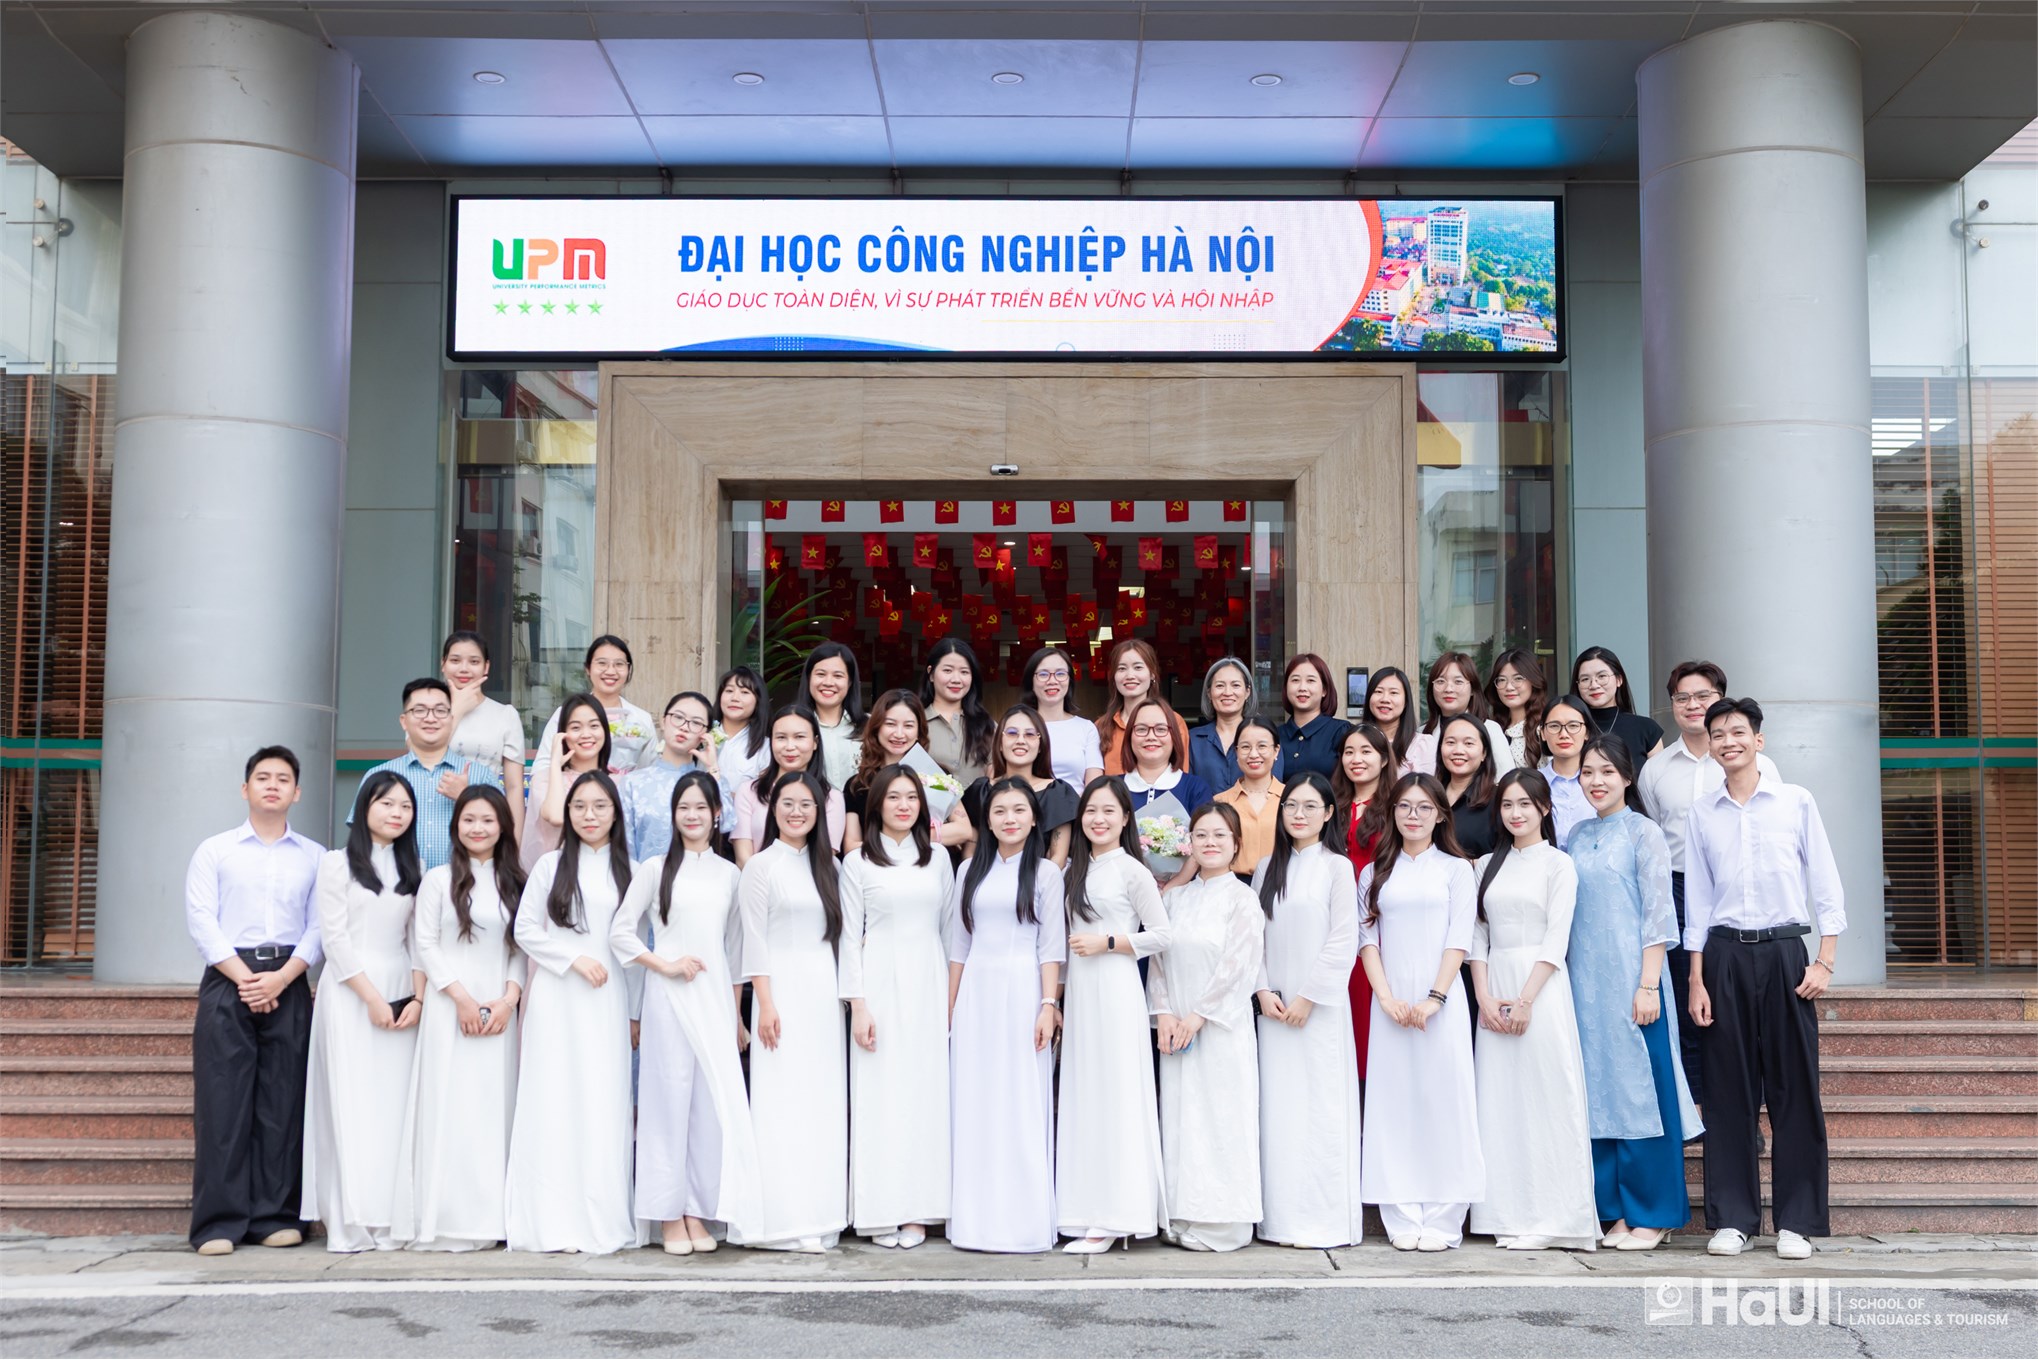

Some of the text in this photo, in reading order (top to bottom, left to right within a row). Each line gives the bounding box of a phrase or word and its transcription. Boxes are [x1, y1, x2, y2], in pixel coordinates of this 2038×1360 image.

[492, 238, 606, 280] UPM
[678, 225, 1275, 282] ĐẠI HỌC CÔNG NGHIỆP HÀ NỘI
[676, 287, 1275, 312] GIÁO DỤC TOÀN DIỆN, VÌ SỰ PHÁT TRIỂN BỀN VỮNG VÀ HỘI NHẬP
